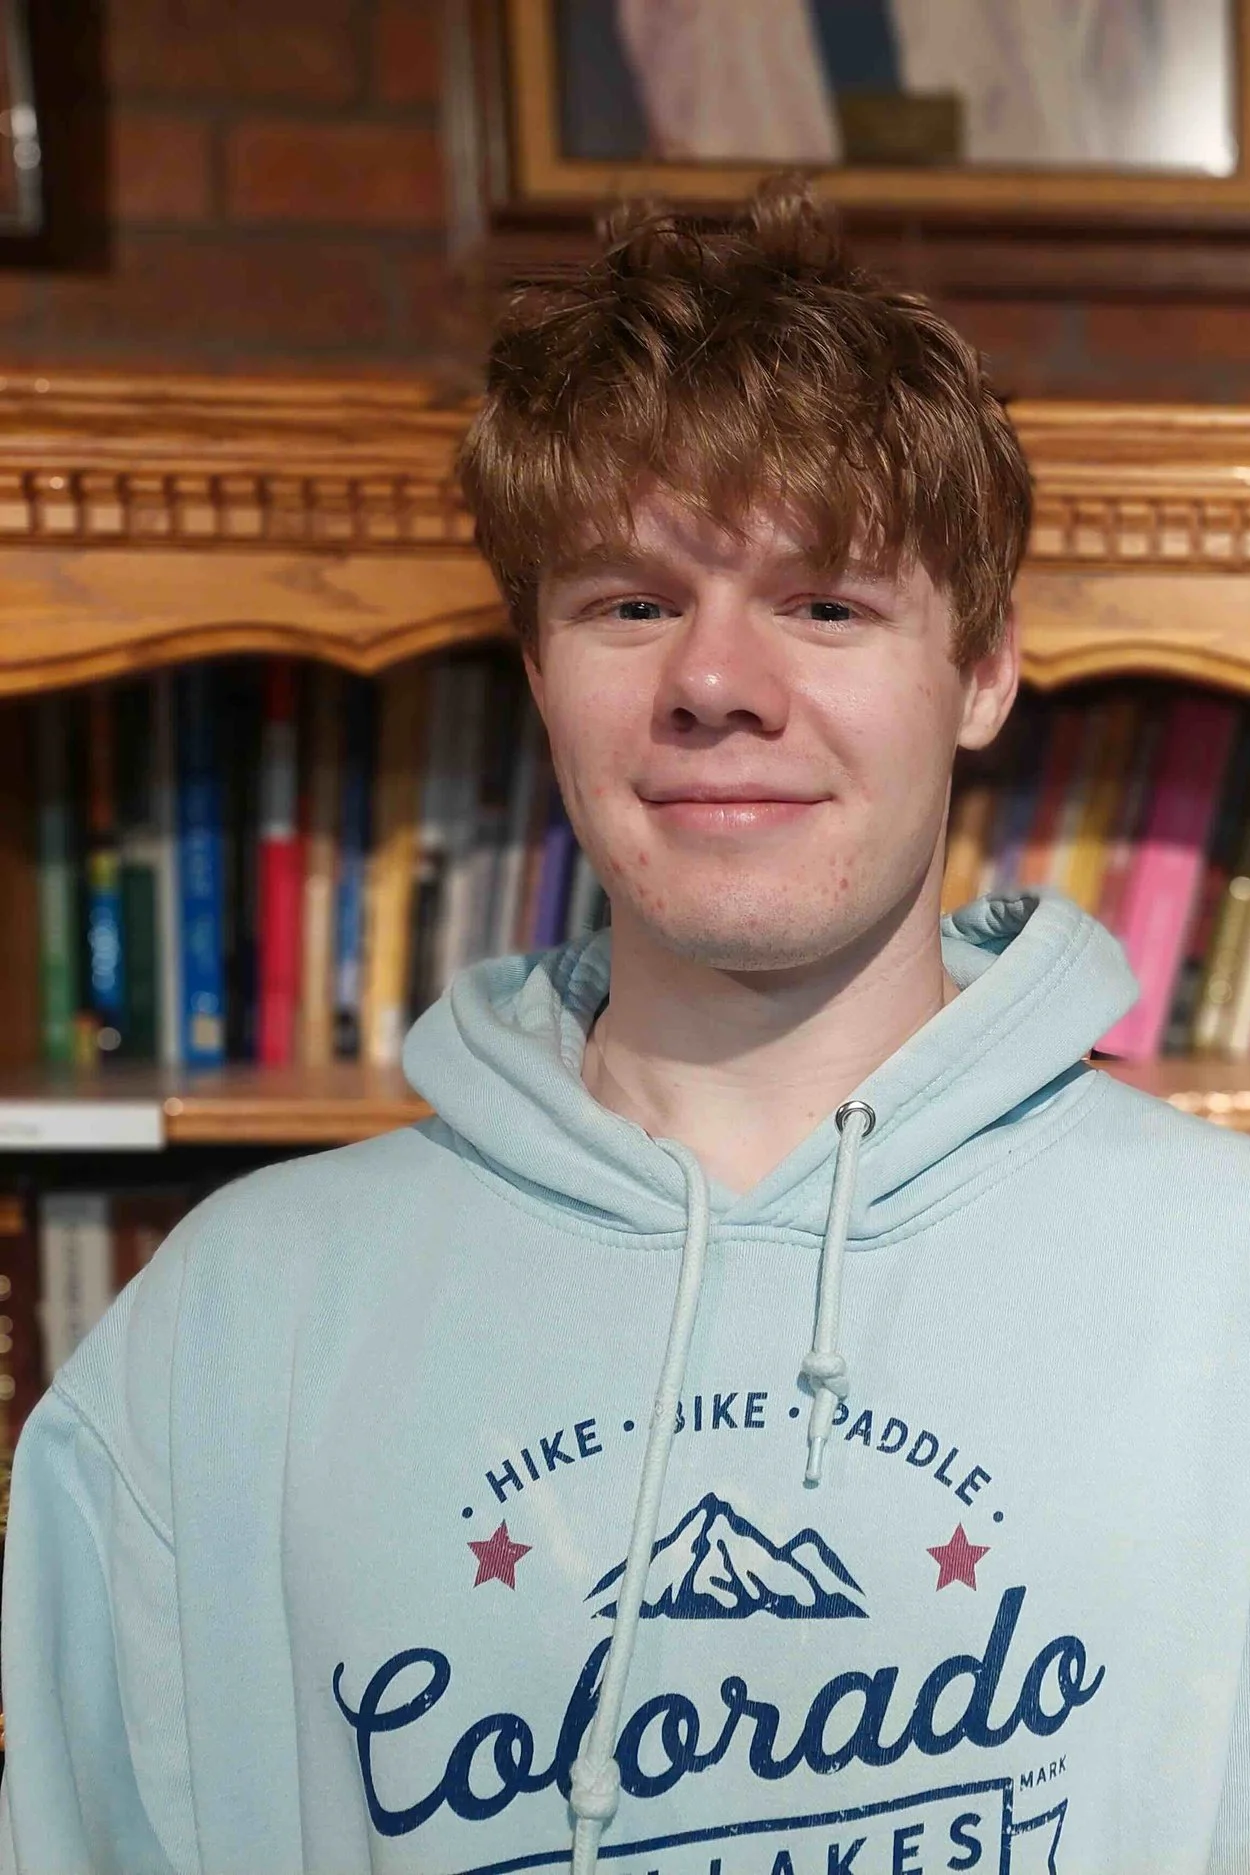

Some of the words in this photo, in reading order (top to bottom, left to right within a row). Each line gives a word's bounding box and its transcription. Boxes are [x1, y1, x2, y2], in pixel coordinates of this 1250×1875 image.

[485, 1418, 603, 1504] HIKE
[332, 1585, 1107, 1837] Colorado
[1020, 1754, 1068, 1792] MARK
